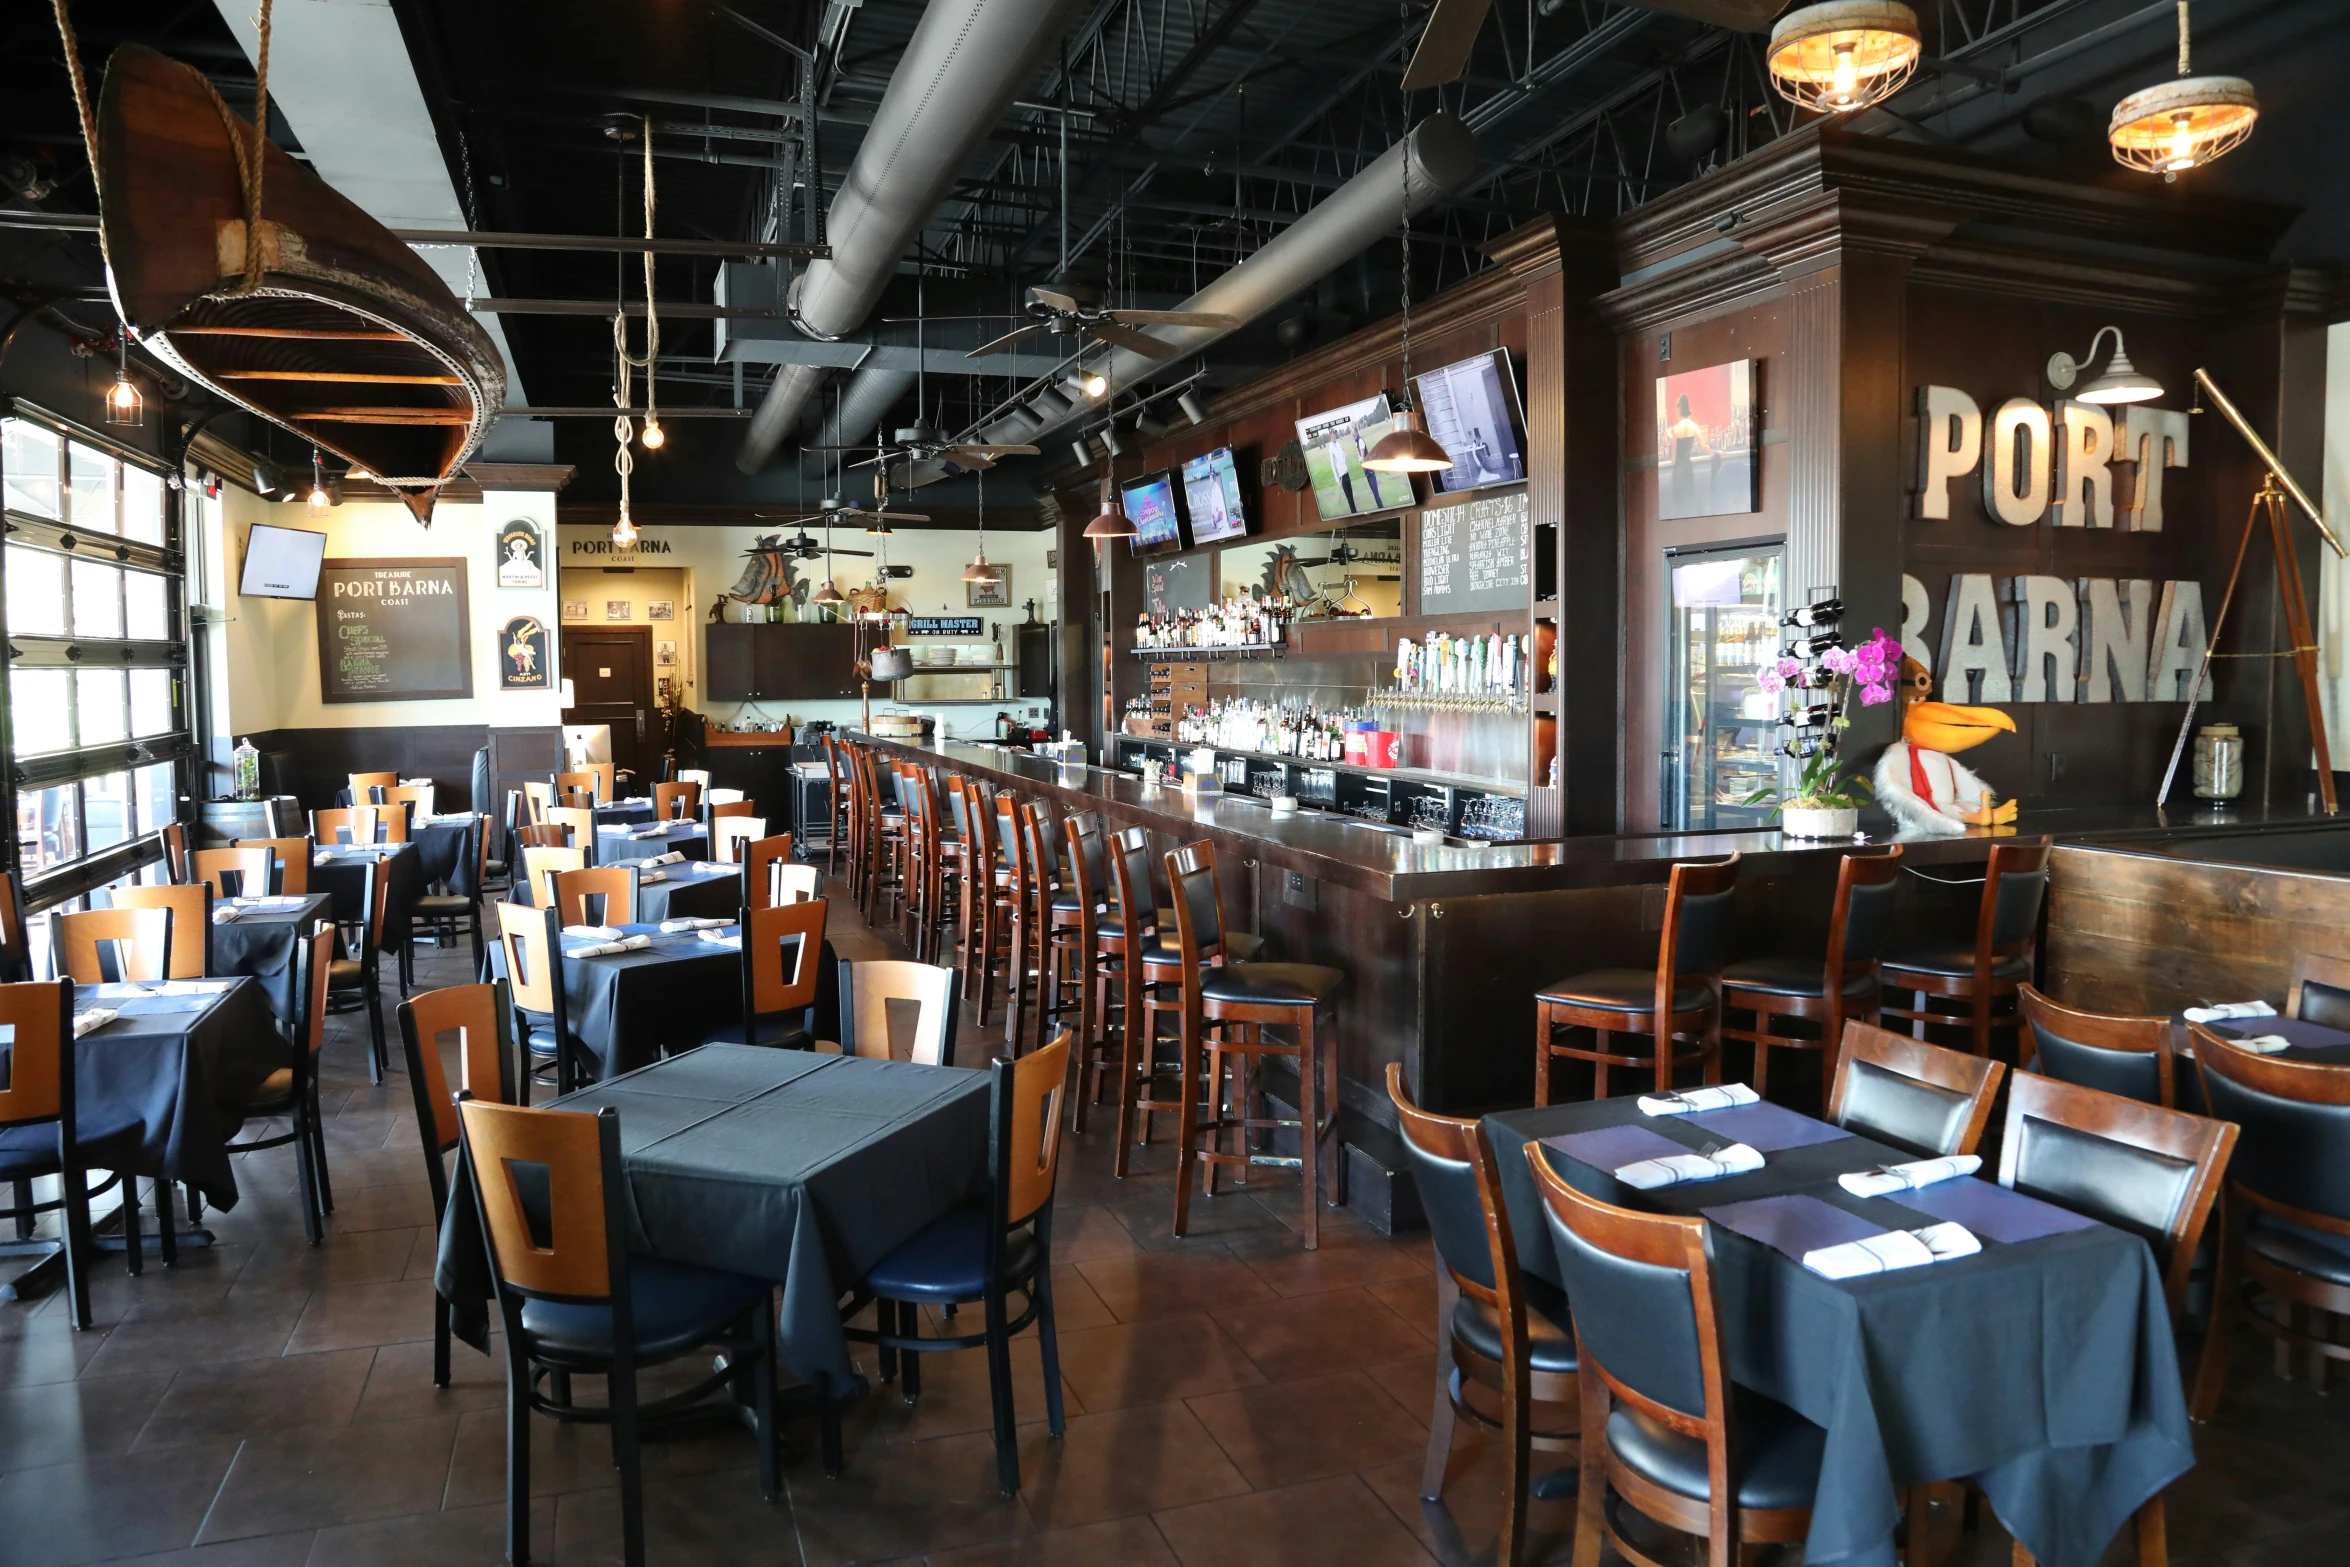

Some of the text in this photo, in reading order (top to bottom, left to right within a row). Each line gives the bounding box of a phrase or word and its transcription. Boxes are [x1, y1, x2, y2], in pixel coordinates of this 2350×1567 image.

[1914, 384, 2189, 532] PORT
[572, 540, 671, 554] PORT ARNA
[334, 580, 453, 597] PORT BARNA
[381, 598, 409, 606] COAST
[911, 618, 979, 629] GRILL MASTER
[508, 674, 542, 682] CINZANO
